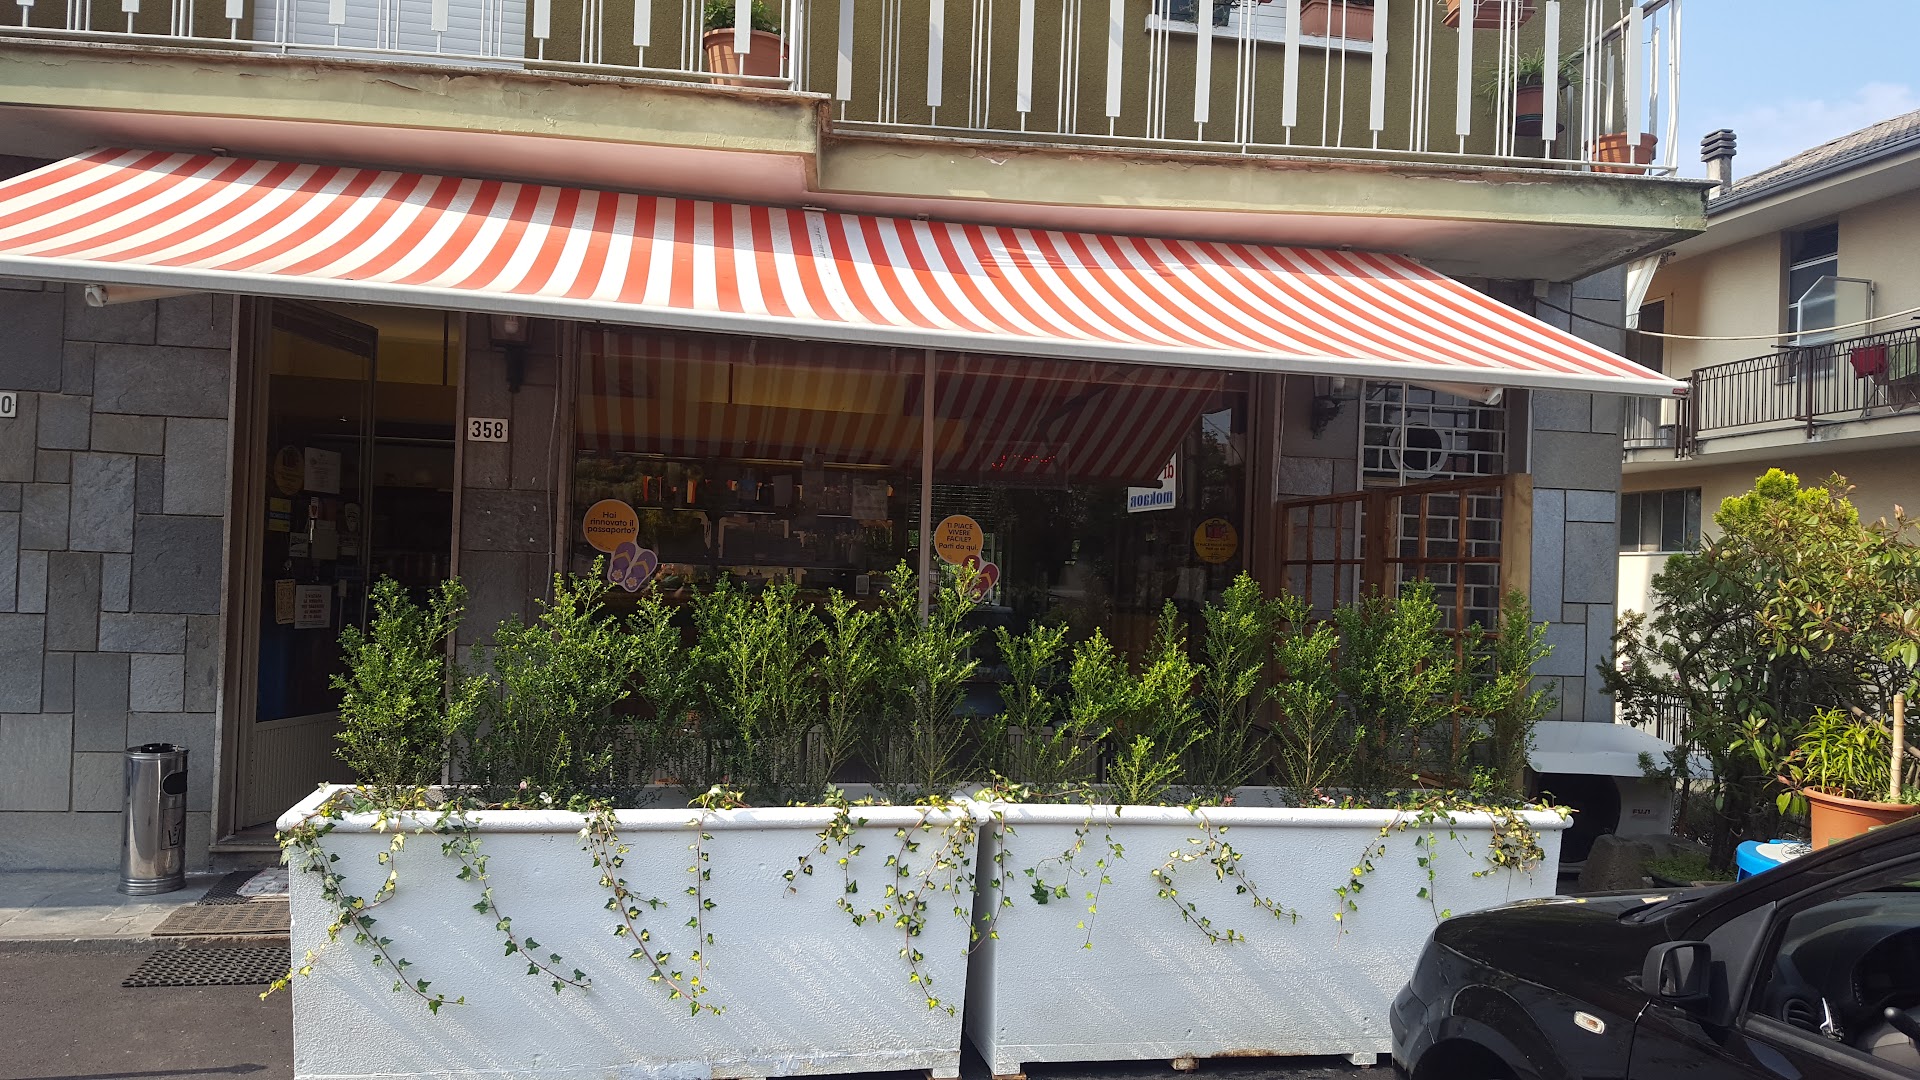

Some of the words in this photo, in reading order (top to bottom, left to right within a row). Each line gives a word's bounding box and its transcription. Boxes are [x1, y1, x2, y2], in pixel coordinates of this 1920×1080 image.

[472, 420, 503, 439] 358
[590, 518, 628, 526] rinnovato
[587, 526, 636, 534] passaporto?
